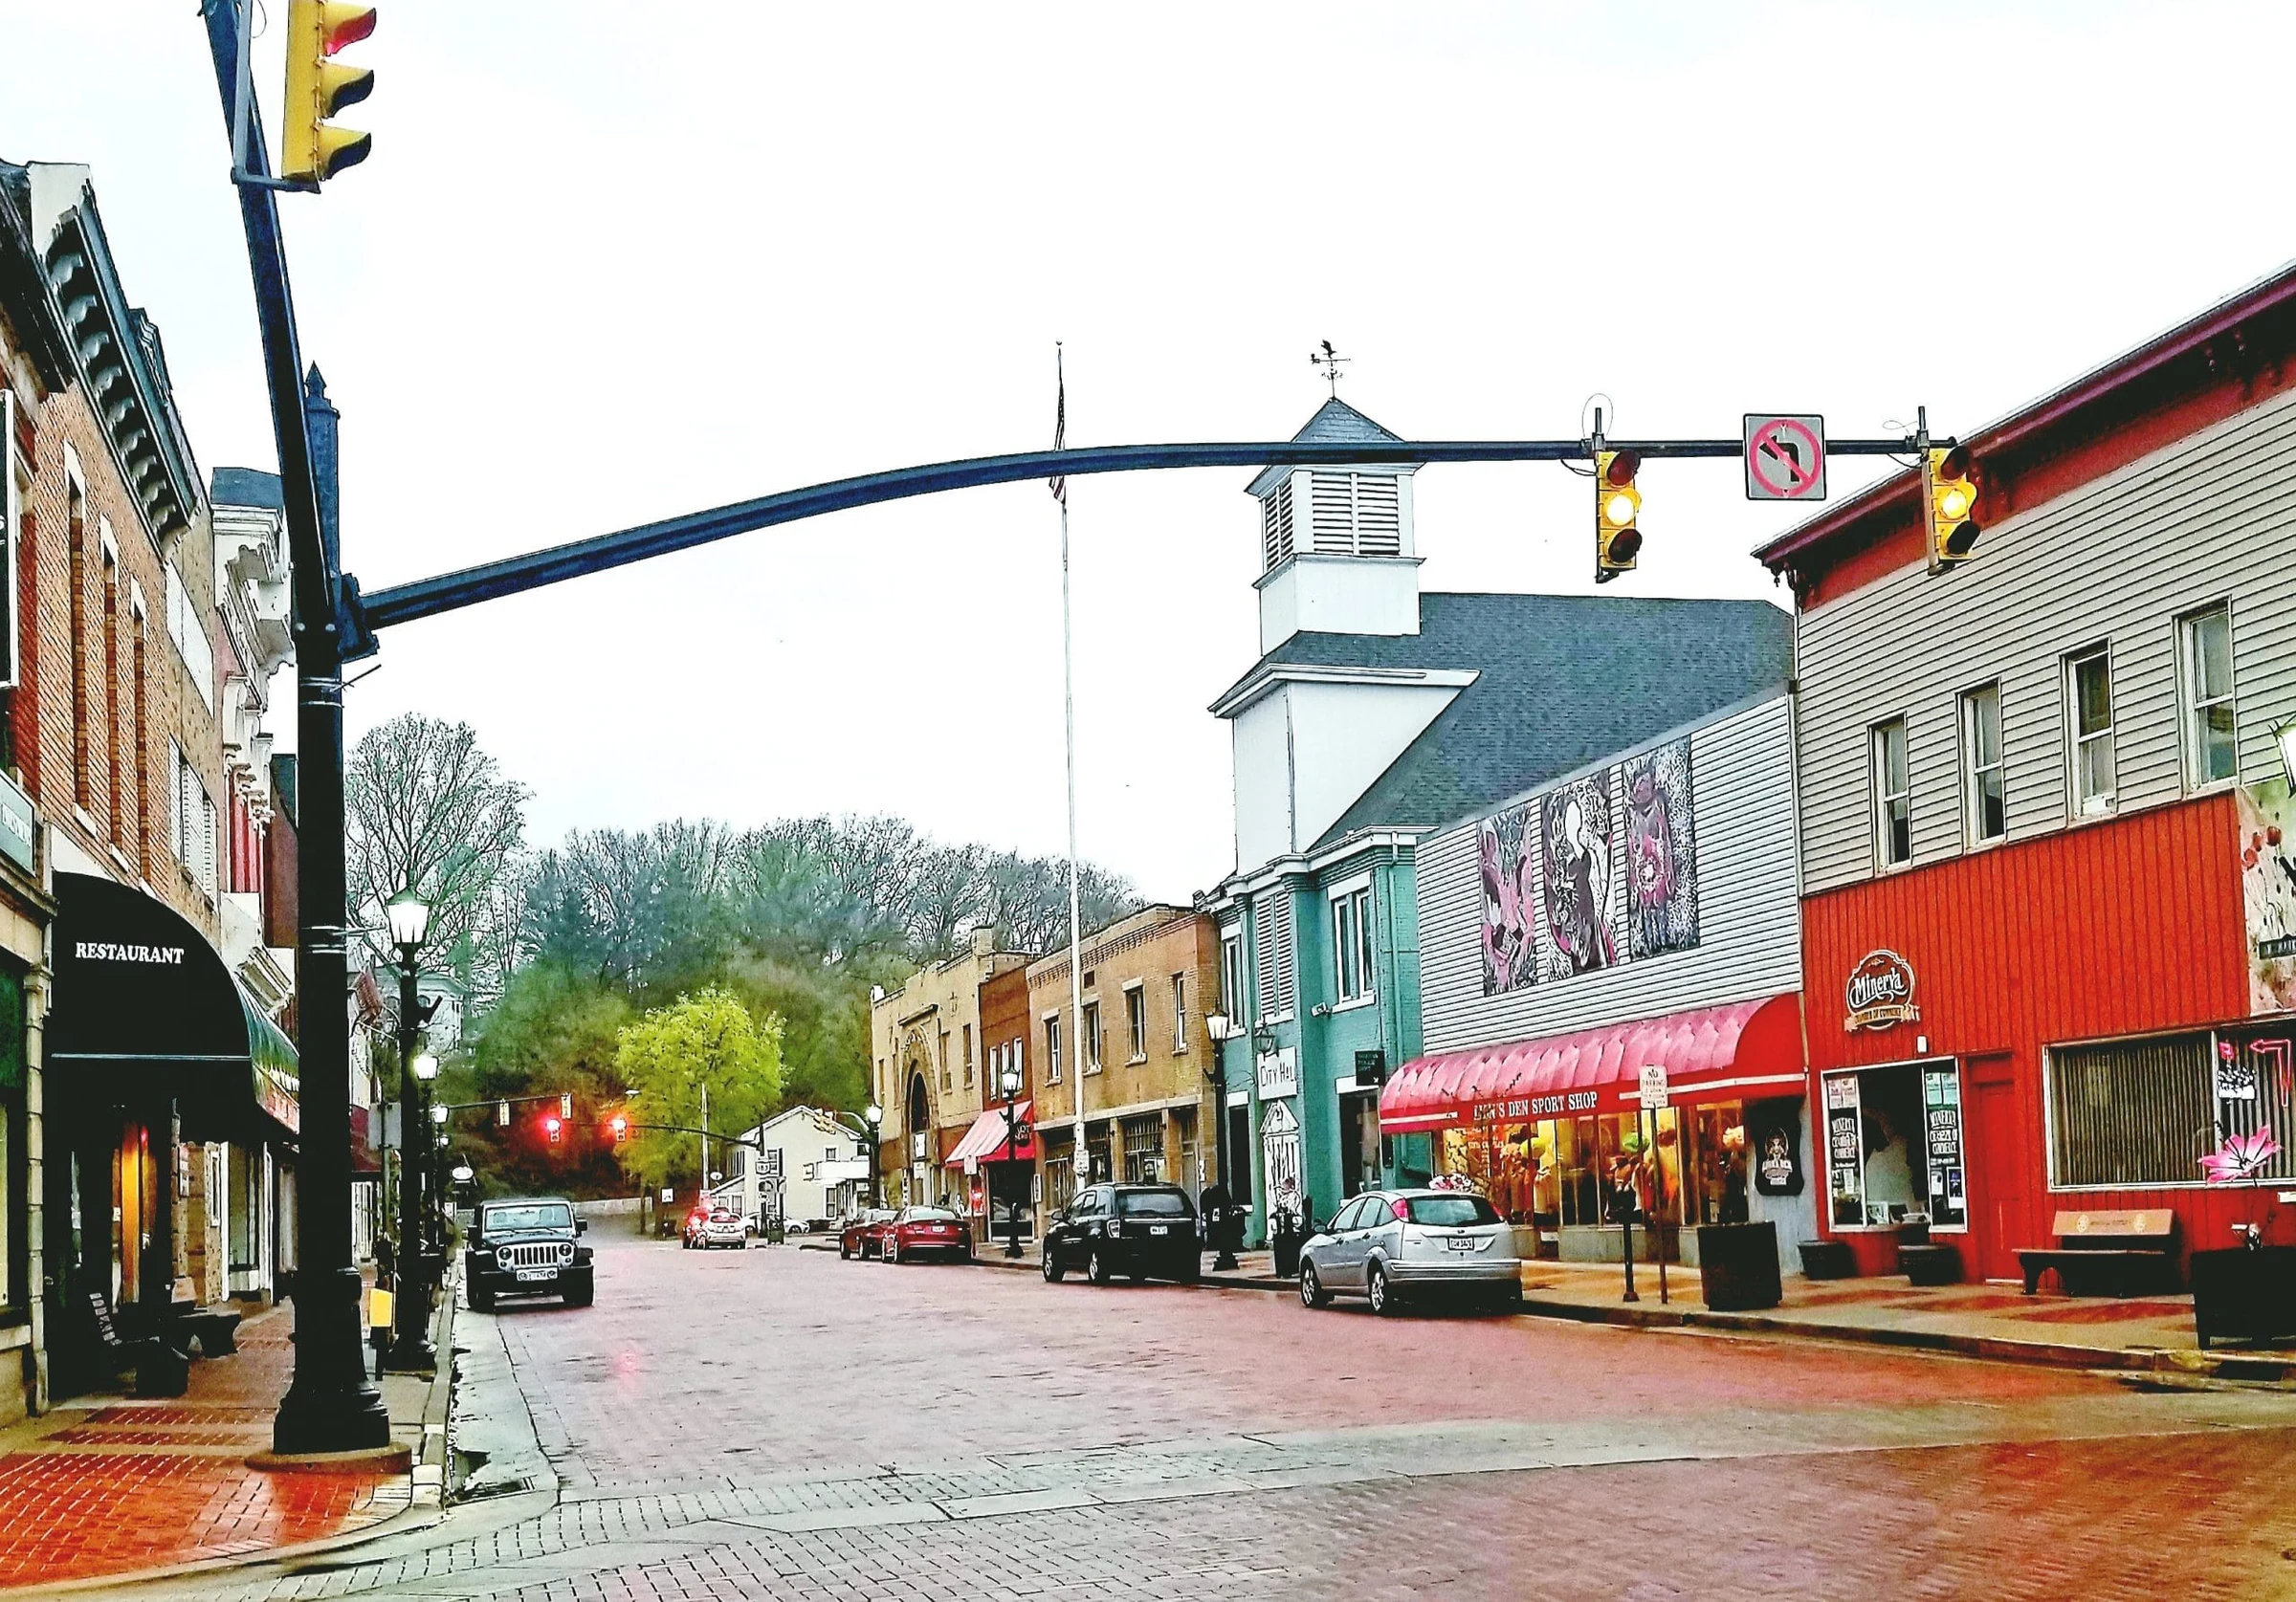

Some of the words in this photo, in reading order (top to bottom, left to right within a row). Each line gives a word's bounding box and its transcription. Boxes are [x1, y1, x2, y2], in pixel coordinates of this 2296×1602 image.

[76, 942, 185, 964] RESTAURANT
[1853, 967, 1905, 1005] Minerva
[1261, 1065, 1277, 1087] CITY
[1647, 1068, 1659, 1079] NO
[1508, 1099, 1529, 1117] DEN
[1532, 1095, 1564, 1114] SPORT
[1568, 1091, 1598, 1110] SHOP
